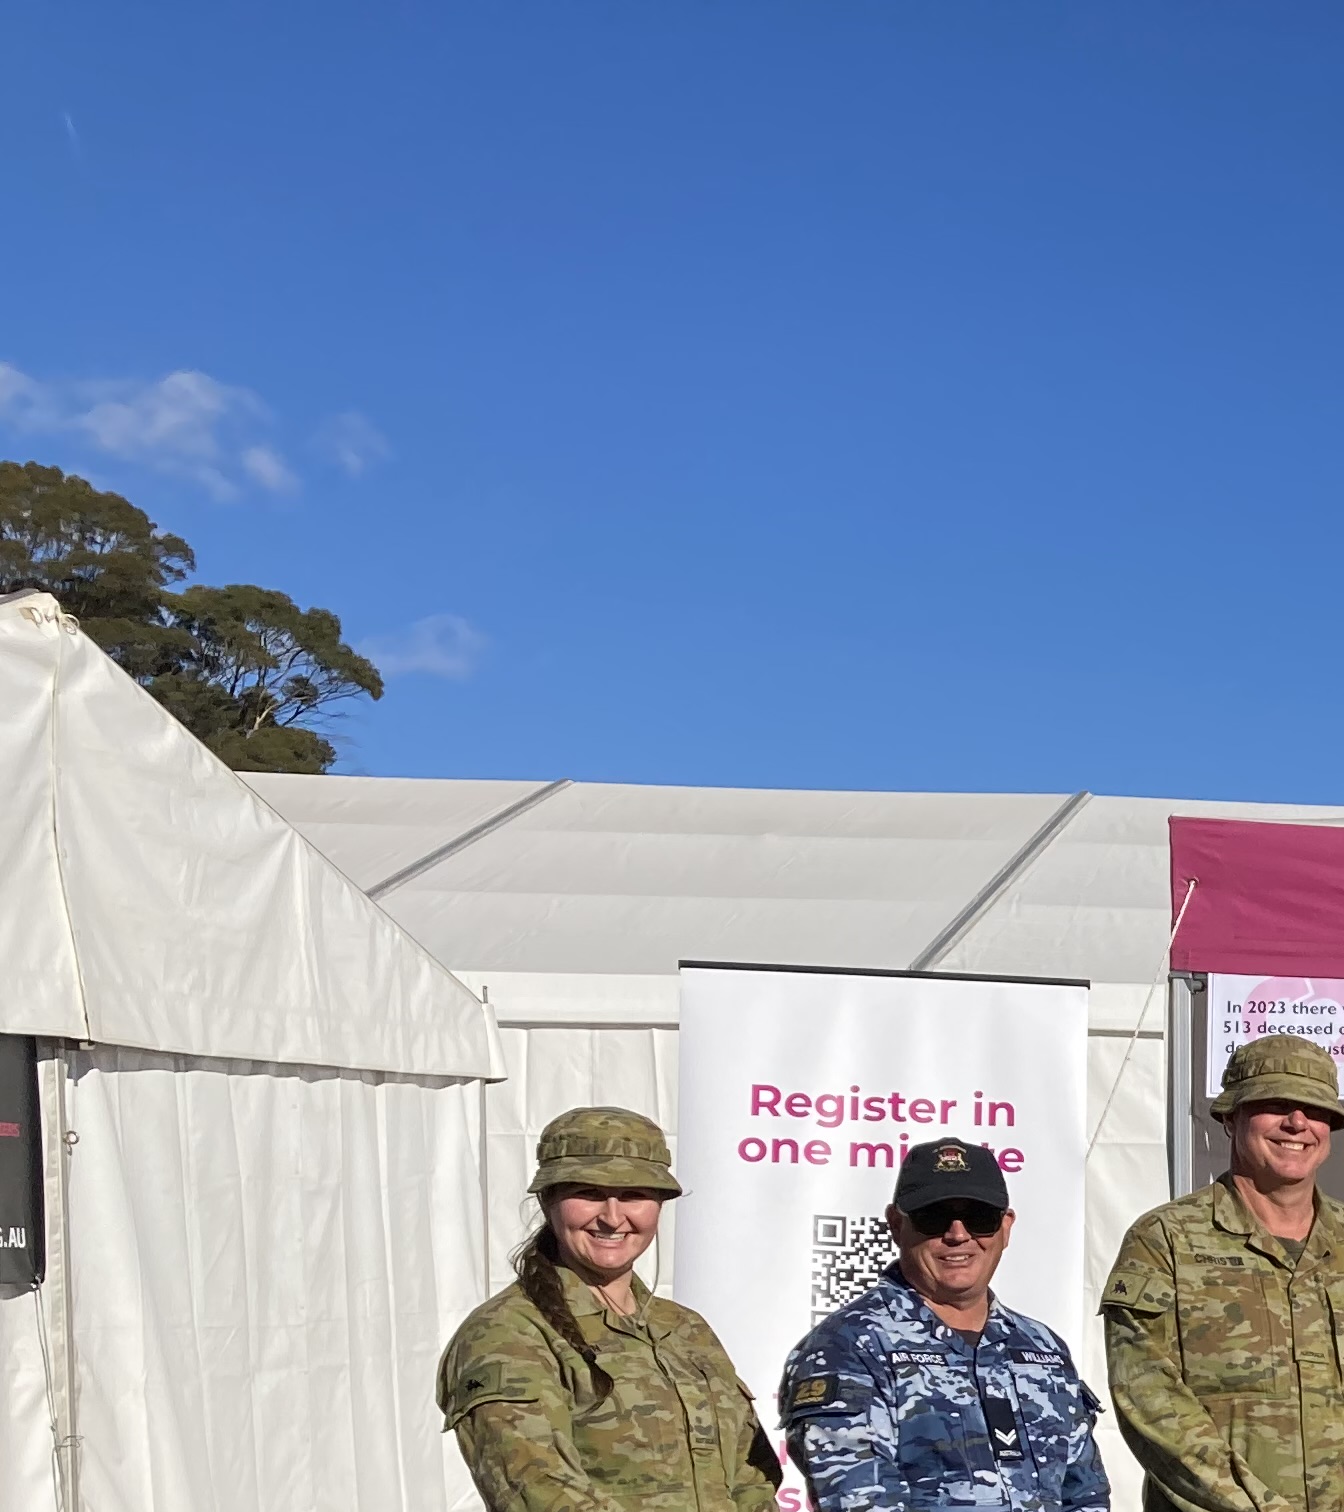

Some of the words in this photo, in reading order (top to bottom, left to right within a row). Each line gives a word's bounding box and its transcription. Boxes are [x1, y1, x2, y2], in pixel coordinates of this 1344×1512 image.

[1227, 1001, 1242, 1013] In
[1248, 1001, 1286, 1014] 2023
[1292, 1002, 1337, 1015] there
[1223, 1020, 1251, 1033] 513
[1257, 1022, 1333, 1035] deceased
[750, 1083, 957, 1128] Register
[973, 1090, 1016, 1127] in
[737, 1137, 832, 1165] one
[849, 1133, 1025, 1173] mie
[891, 1352, 911, 1364] AIR
[911, 1352, 945, 1366] FORCE
[796, 1379, 828, 1400] 29
